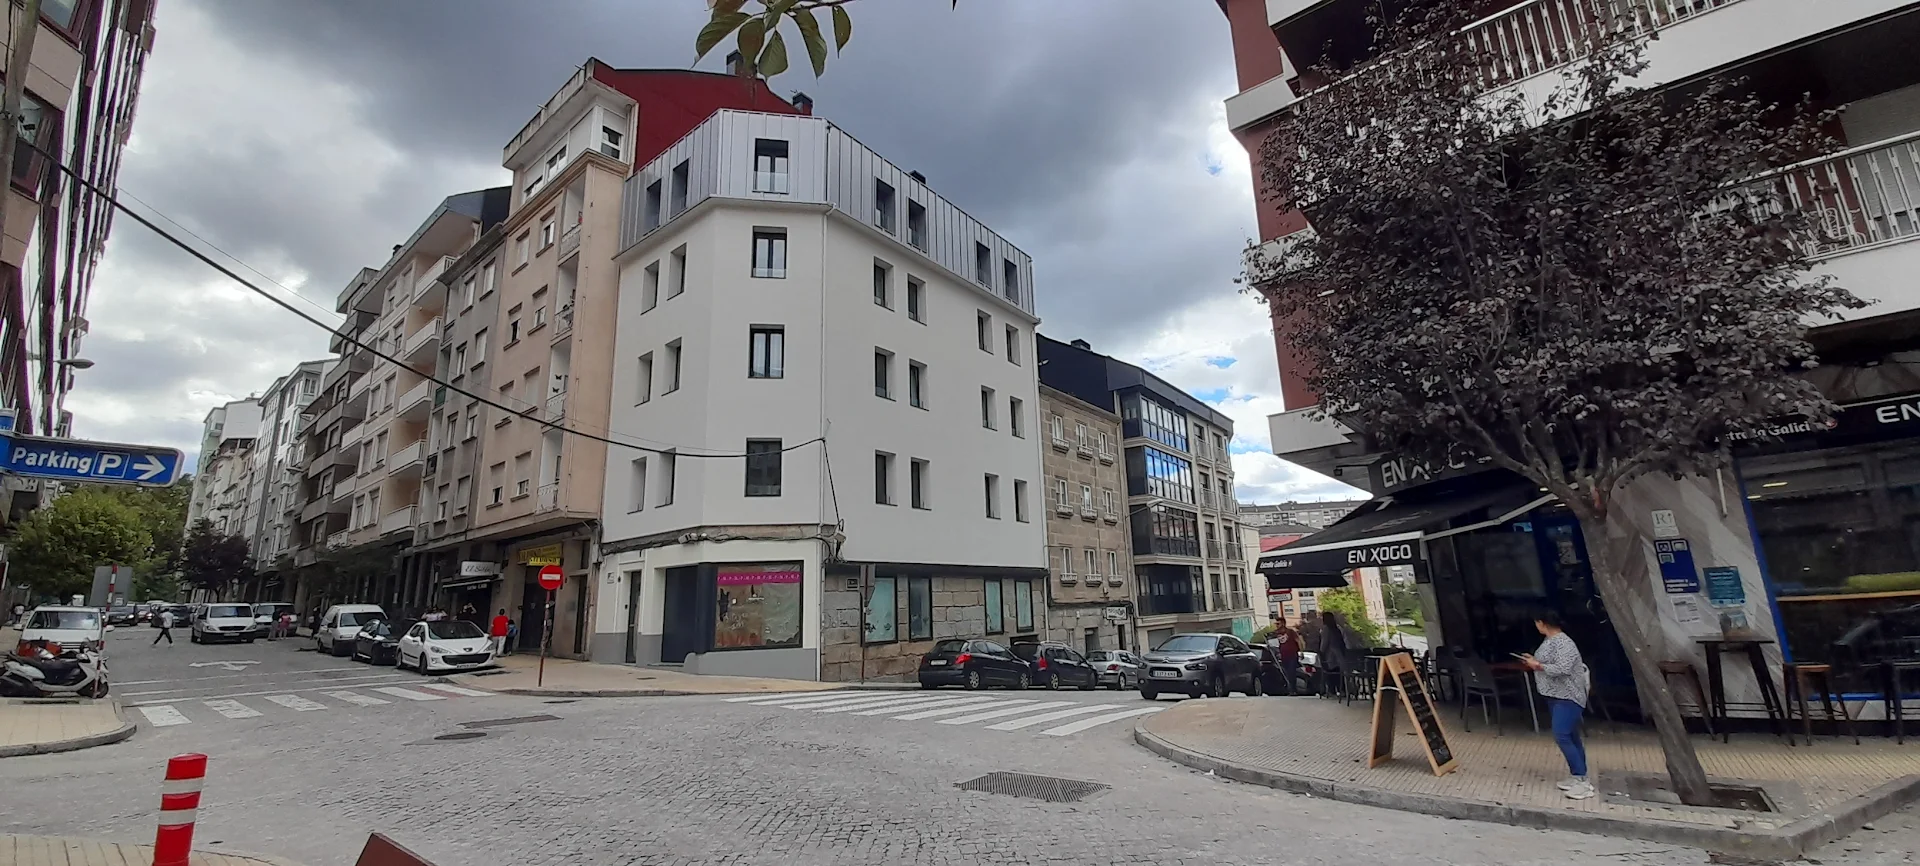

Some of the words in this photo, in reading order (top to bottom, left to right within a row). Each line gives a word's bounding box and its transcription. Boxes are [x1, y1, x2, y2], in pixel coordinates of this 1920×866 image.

[1768, 421, 1811, 437] Galici
[12, 447, 92, 474] Parking
[1381, 457, 1407, 488] EN
[1348, 549, 1367, 564] EN
[1370, 544, 1412, 564] XOGO
